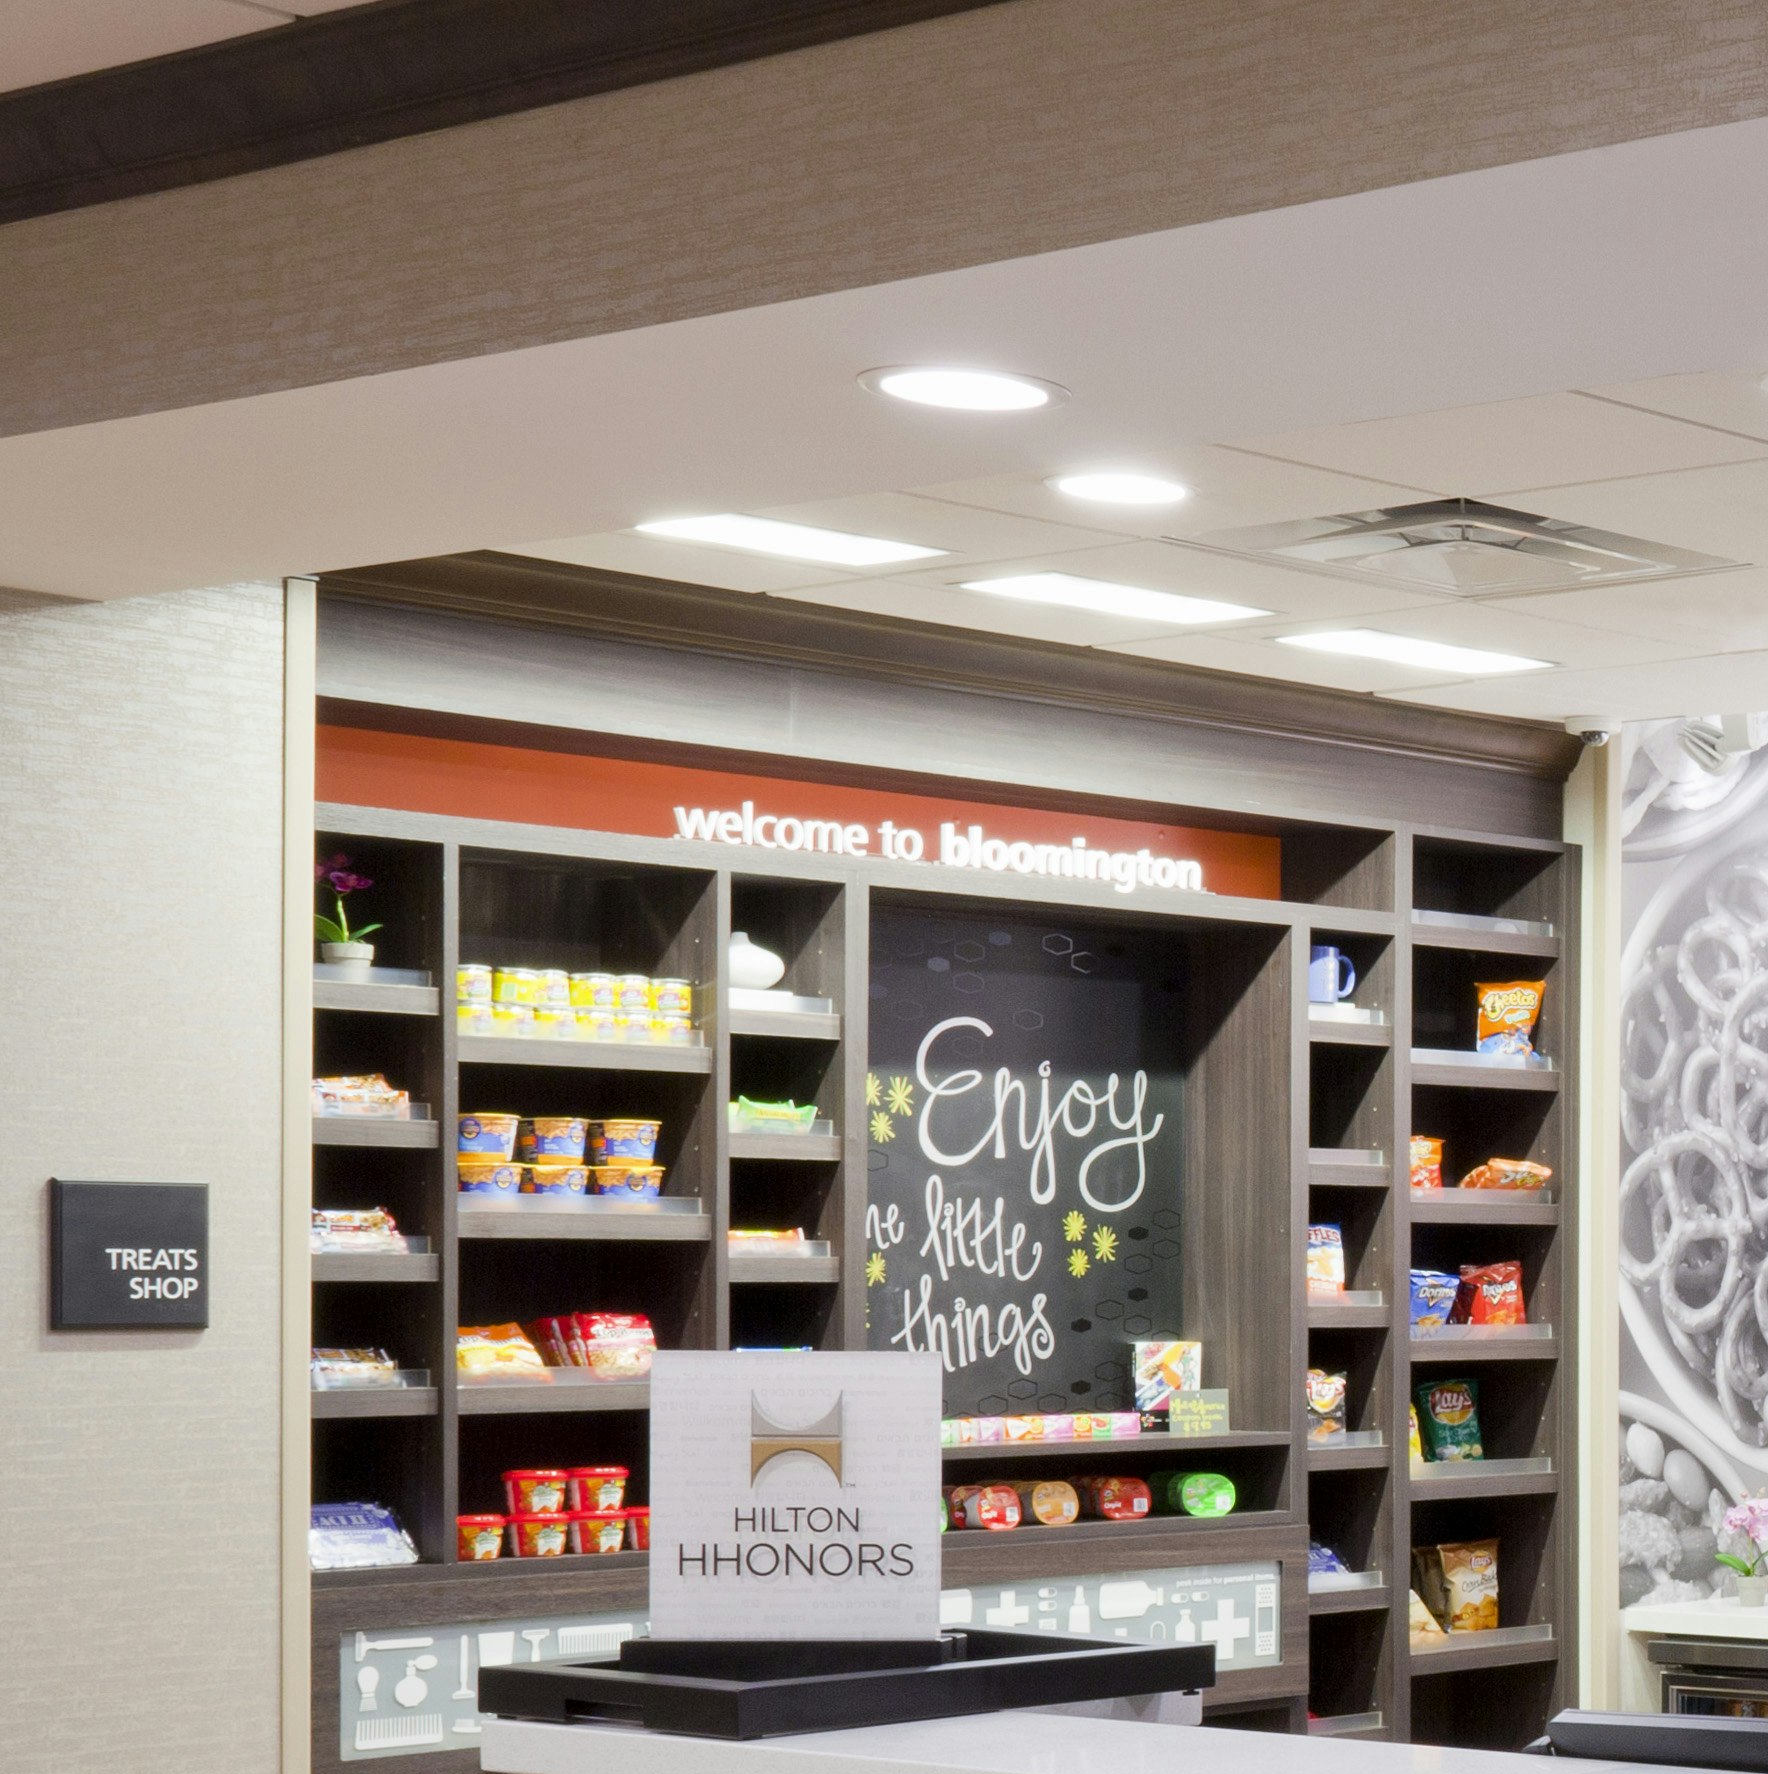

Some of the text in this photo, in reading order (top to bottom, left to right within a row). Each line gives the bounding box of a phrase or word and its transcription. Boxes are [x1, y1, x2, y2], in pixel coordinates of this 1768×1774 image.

[674, 802, 1204, 893] welcome to bloomington
[1484, 990, 1536, 1020] Cheetos
[915, 1016, 1164, 1213] Enjoy
[920, 1174, 1042, 1282] little
[1308, 1227, 1340, 1243] FFLES
[105, 1248, 198, 1271] TREATS
[129, 1277, 198, 1300] SHOP
[890, 1273, 1055, 1376] things
[734, 1507, 859, 1533] HILTON
[679, 1543, 915, 1576] HHONORS
